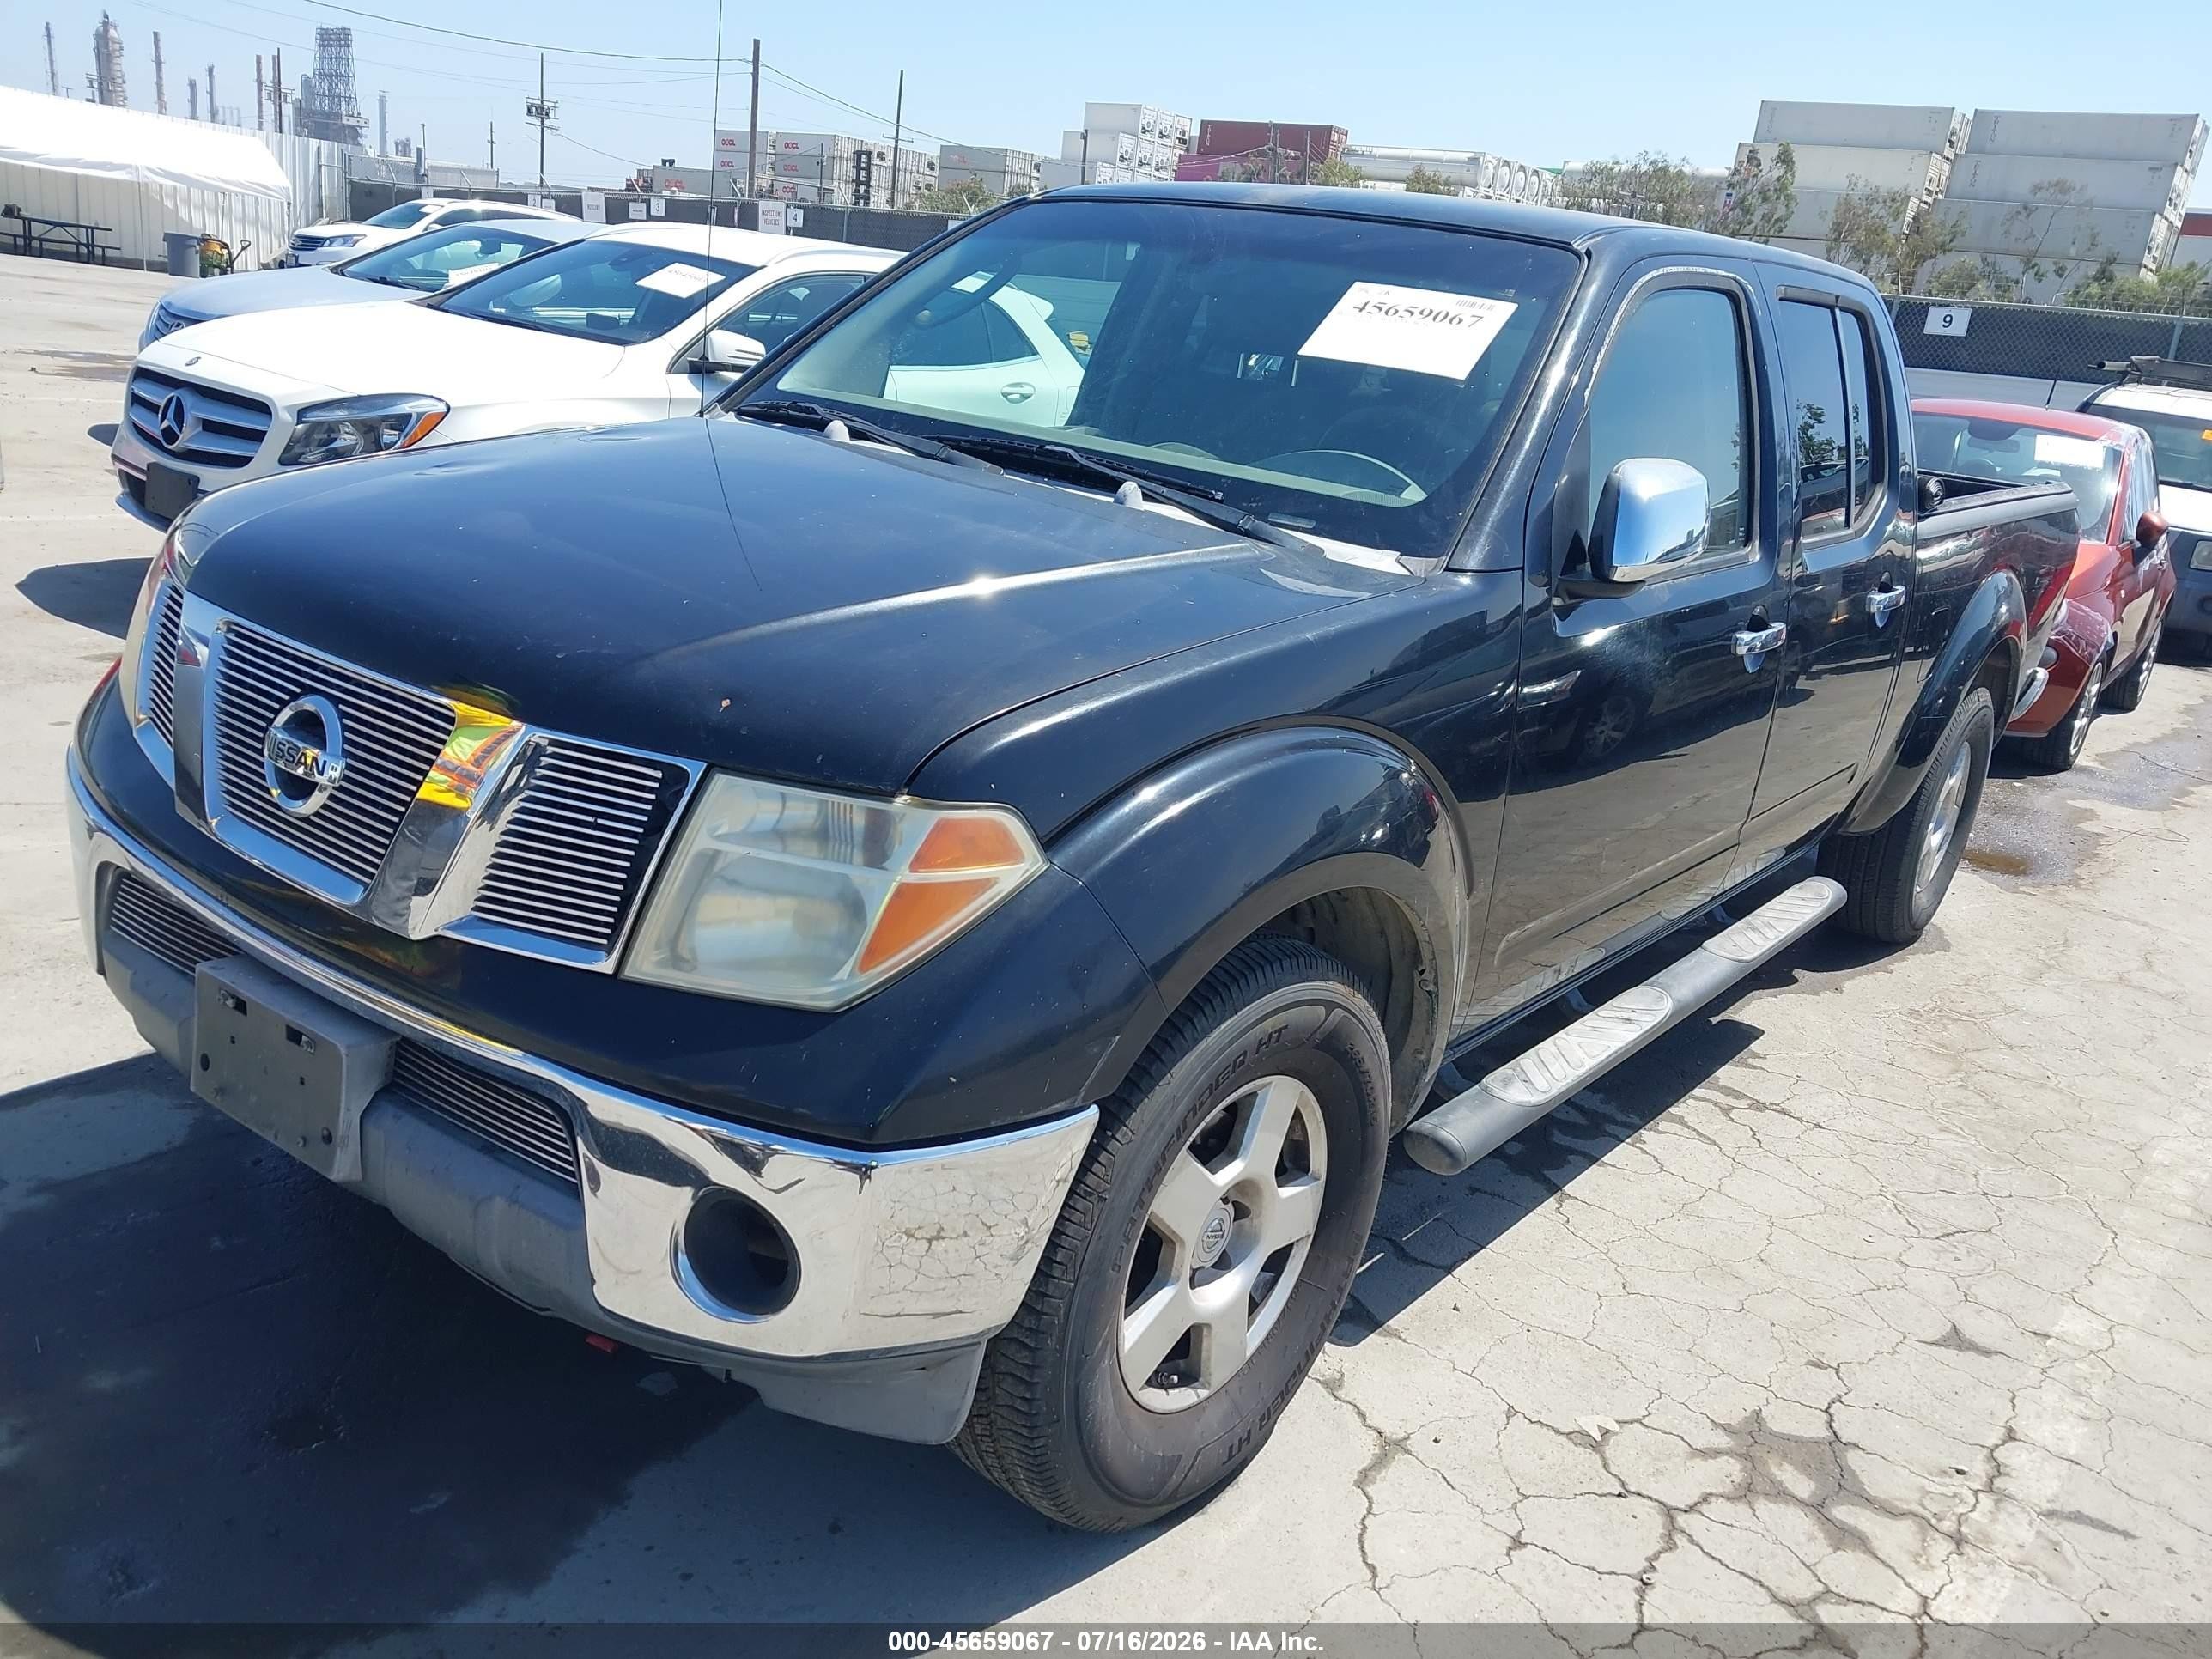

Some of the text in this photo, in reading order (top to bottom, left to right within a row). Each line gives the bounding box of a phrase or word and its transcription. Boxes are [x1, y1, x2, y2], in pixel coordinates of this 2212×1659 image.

[721, 138, 736, 147] OOCL
[655, 203, 659, 212] 3
[793, 212, 798, 222] 4
[1353, 300, 1484, 328] 45659067
[1942, 313, 1954, 329] 9
[267, 730, 327, 777] NISSAN
